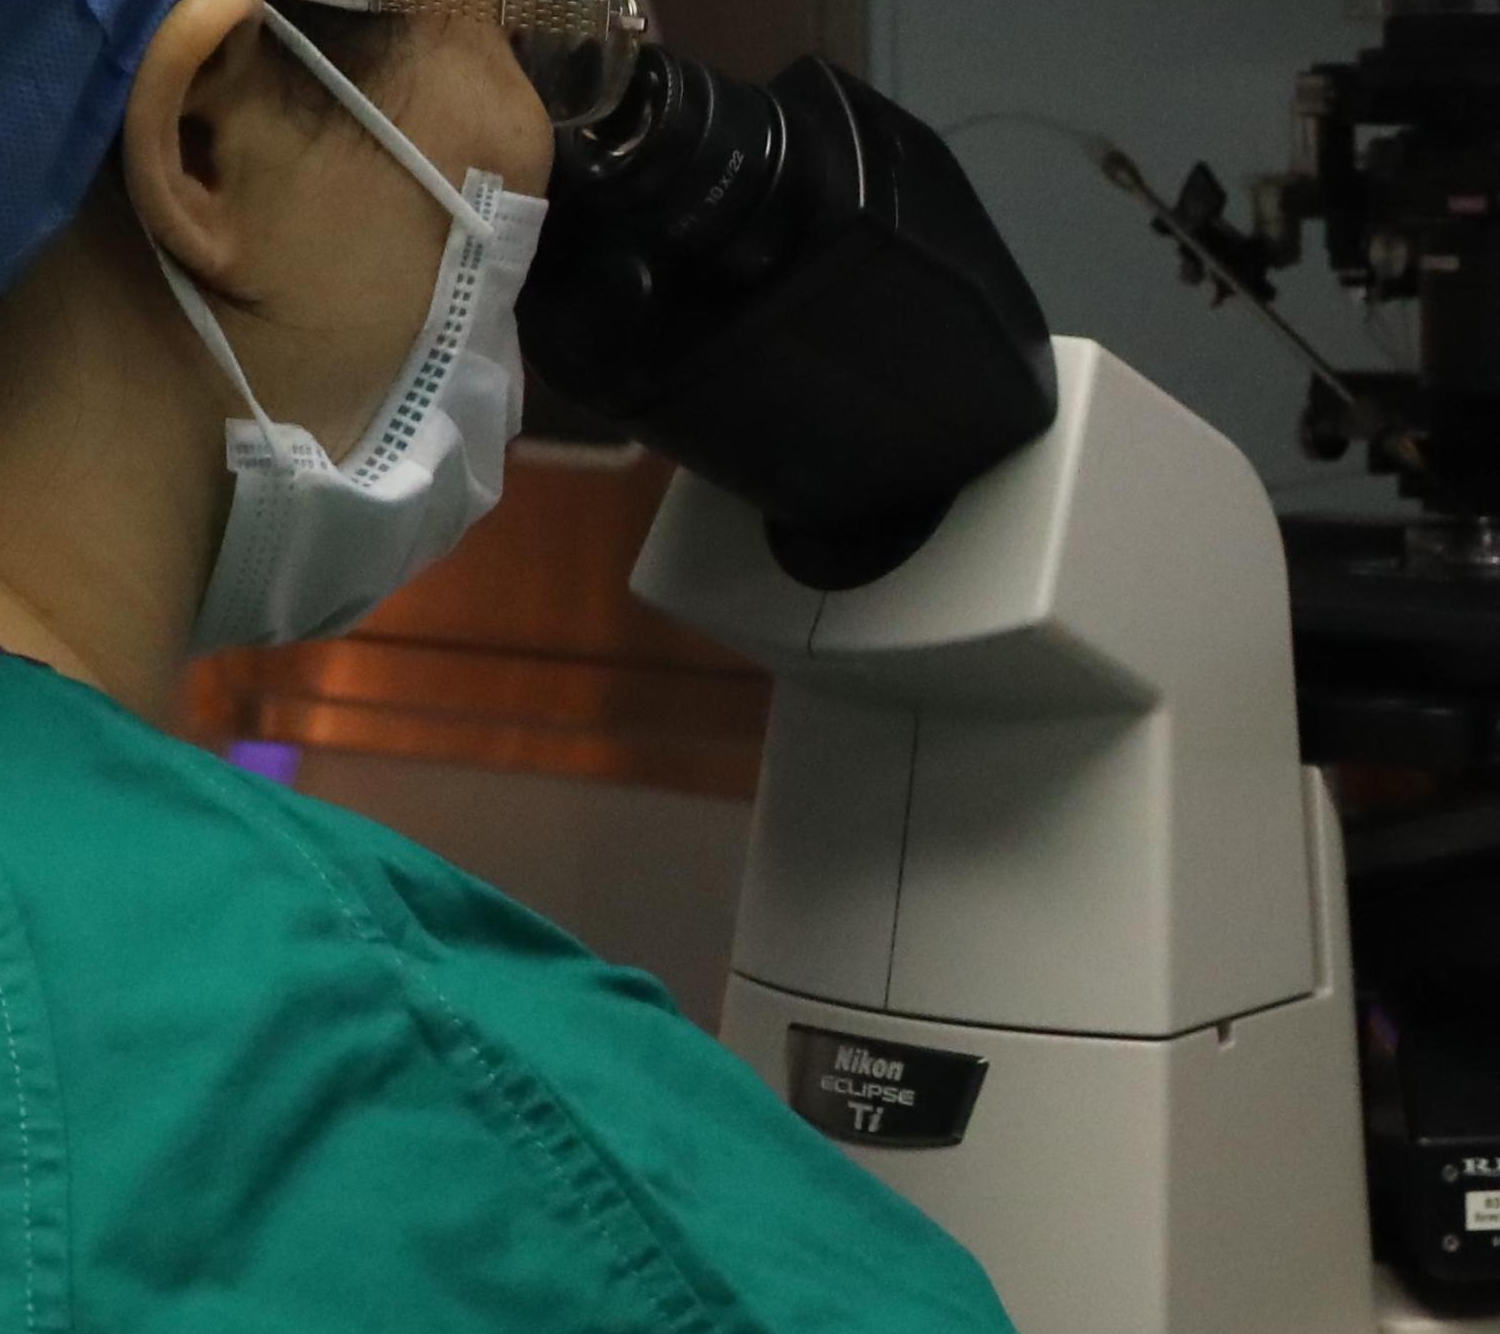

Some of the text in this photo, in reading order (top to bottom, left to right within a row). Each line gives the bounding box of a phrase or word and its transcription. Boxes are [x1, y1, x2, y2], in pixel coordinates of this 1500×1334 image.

[834, 1046, 905, 1082] Nikon
[821, 1075, 916, 1106] ECLIPSE
[847, 1101, 885, 1133] Ti
